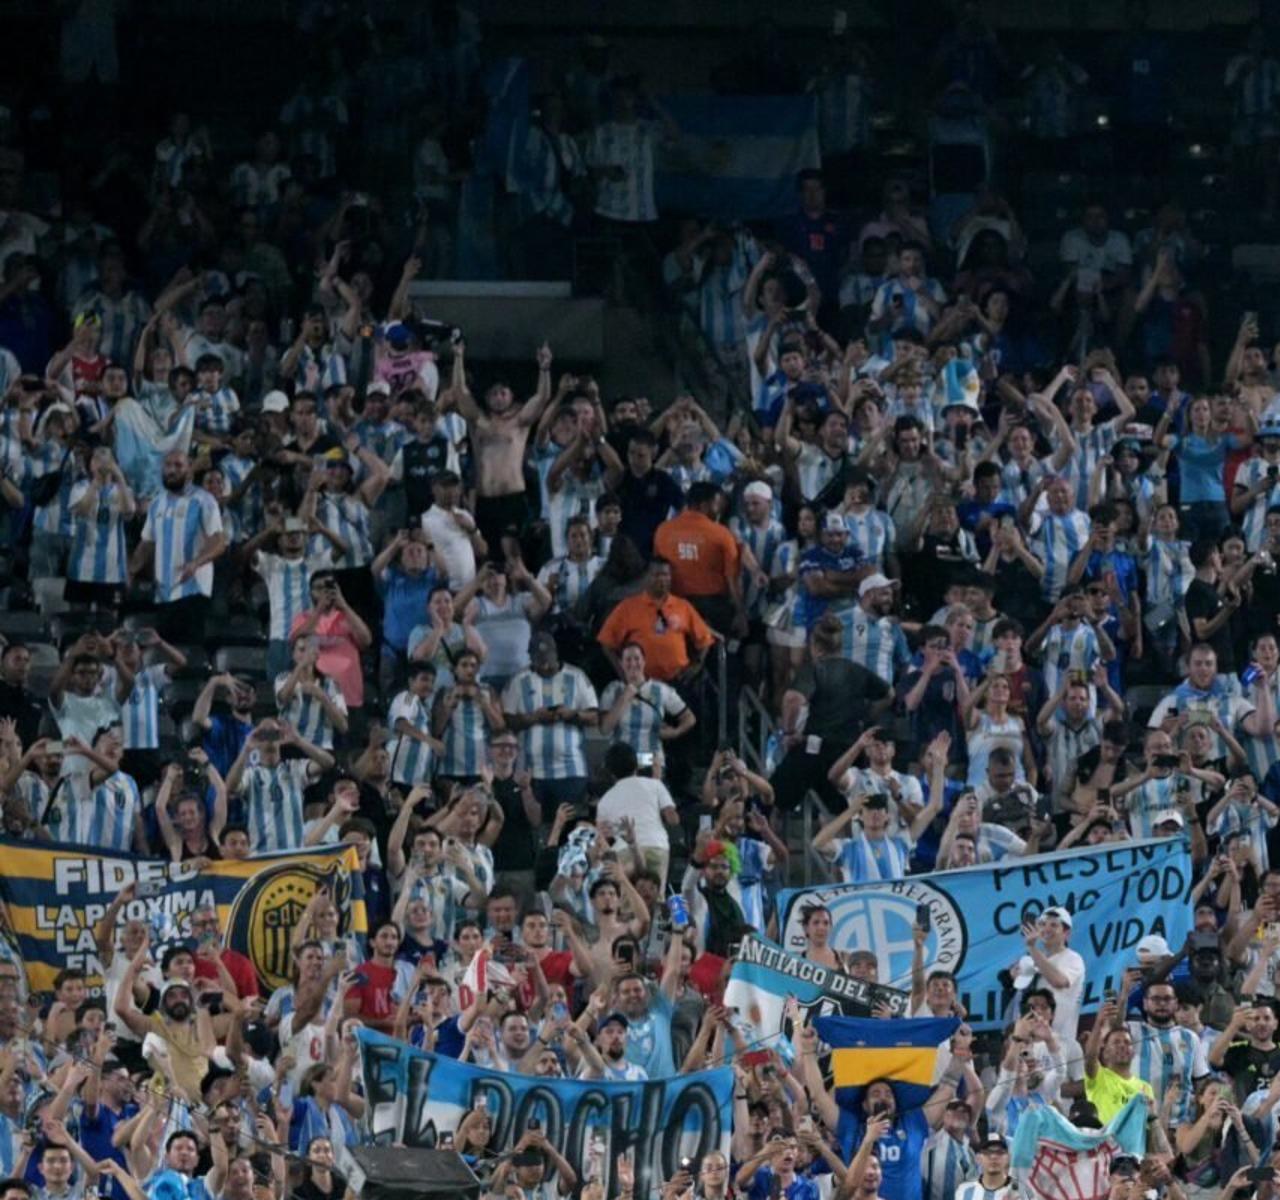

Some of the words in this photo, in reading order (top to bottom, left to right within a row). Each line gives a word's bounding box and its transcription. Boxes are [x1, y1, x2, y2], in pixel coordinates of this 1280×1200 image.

[737, 932, 826, 987] ANTIAGO
[829, 974, 868, 1002] DEL
[879, 1144, 900, 1162] 10
